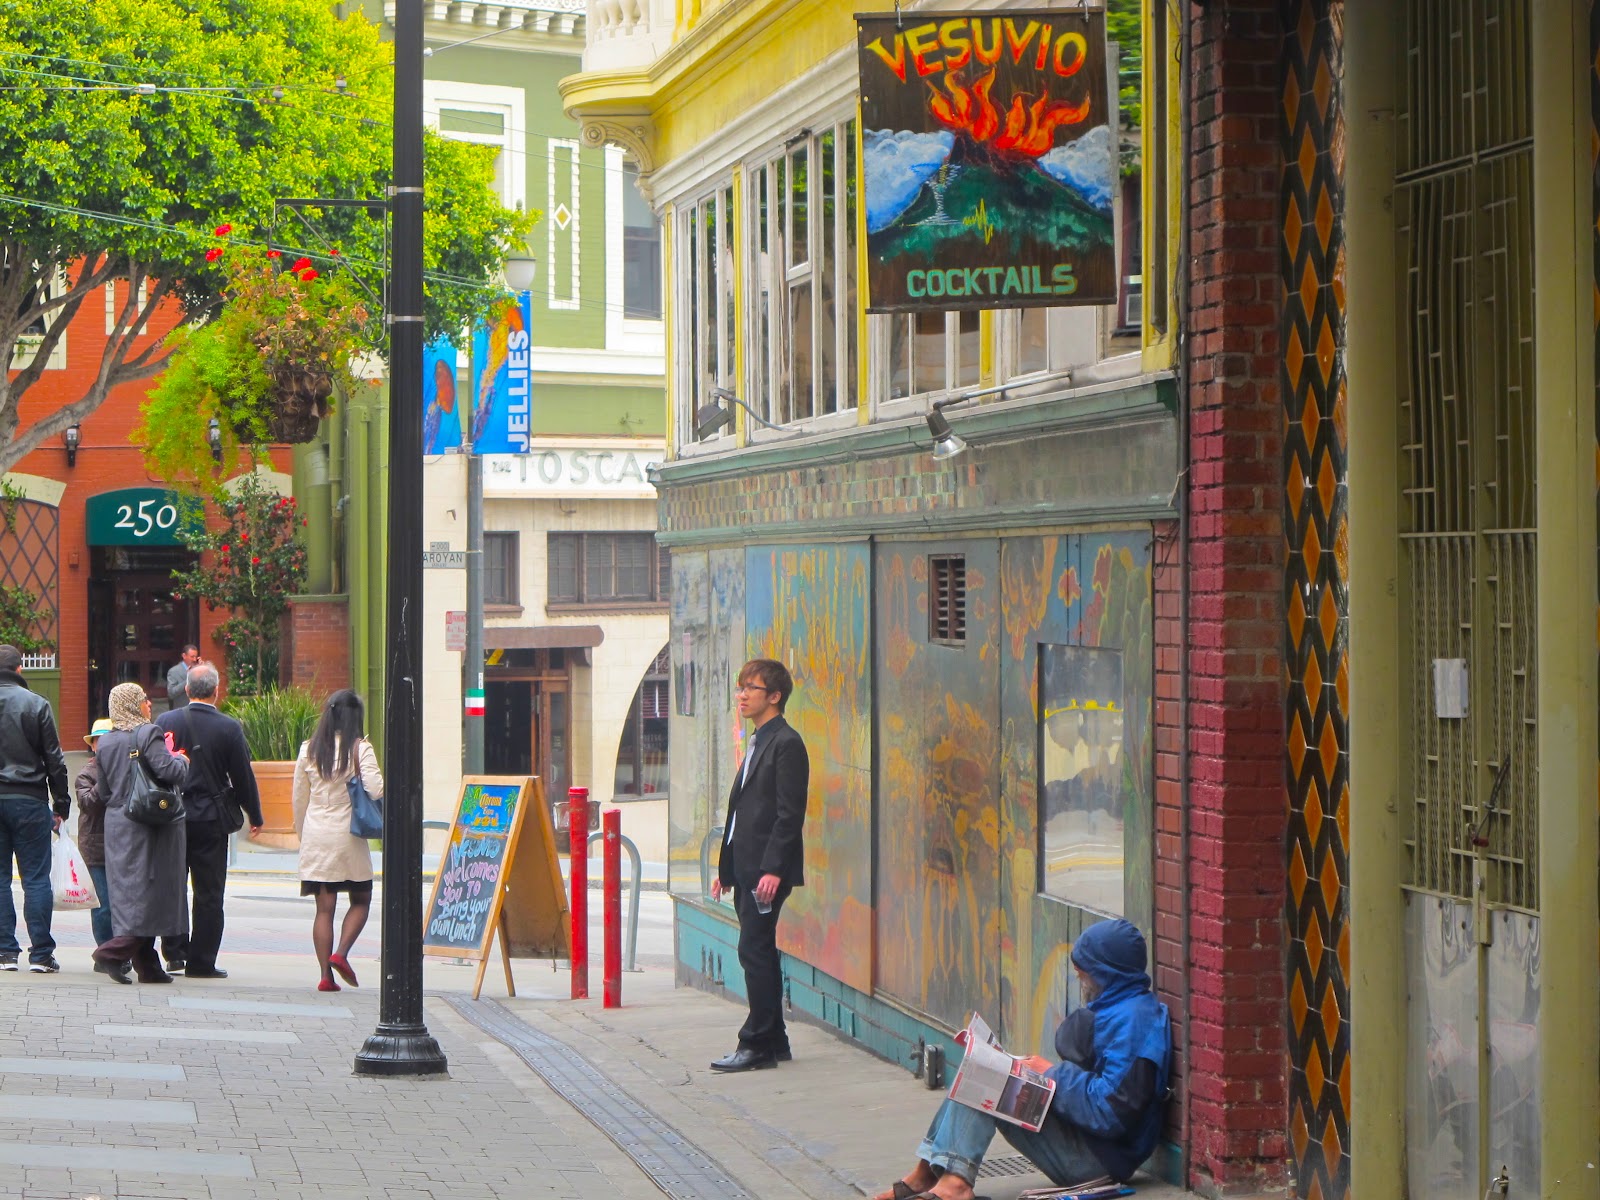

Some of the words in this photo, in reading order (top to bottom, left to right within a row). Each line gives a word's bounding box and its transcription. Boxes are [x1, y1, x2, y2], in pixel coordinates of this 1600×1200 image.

[864, 17, 1088, 83] VESUVIO
[907, 263, 1077, 297] COCKTAILS
[508, 329, 529, 452] JELLIES
[513, 452, 644, 484] TOSCA
[114, 500, 176, 537] 250
[423, 553, 463, 563] AROYAN
[438, 900, 469, 920] Bring
[466, 897, 492, 922] your
